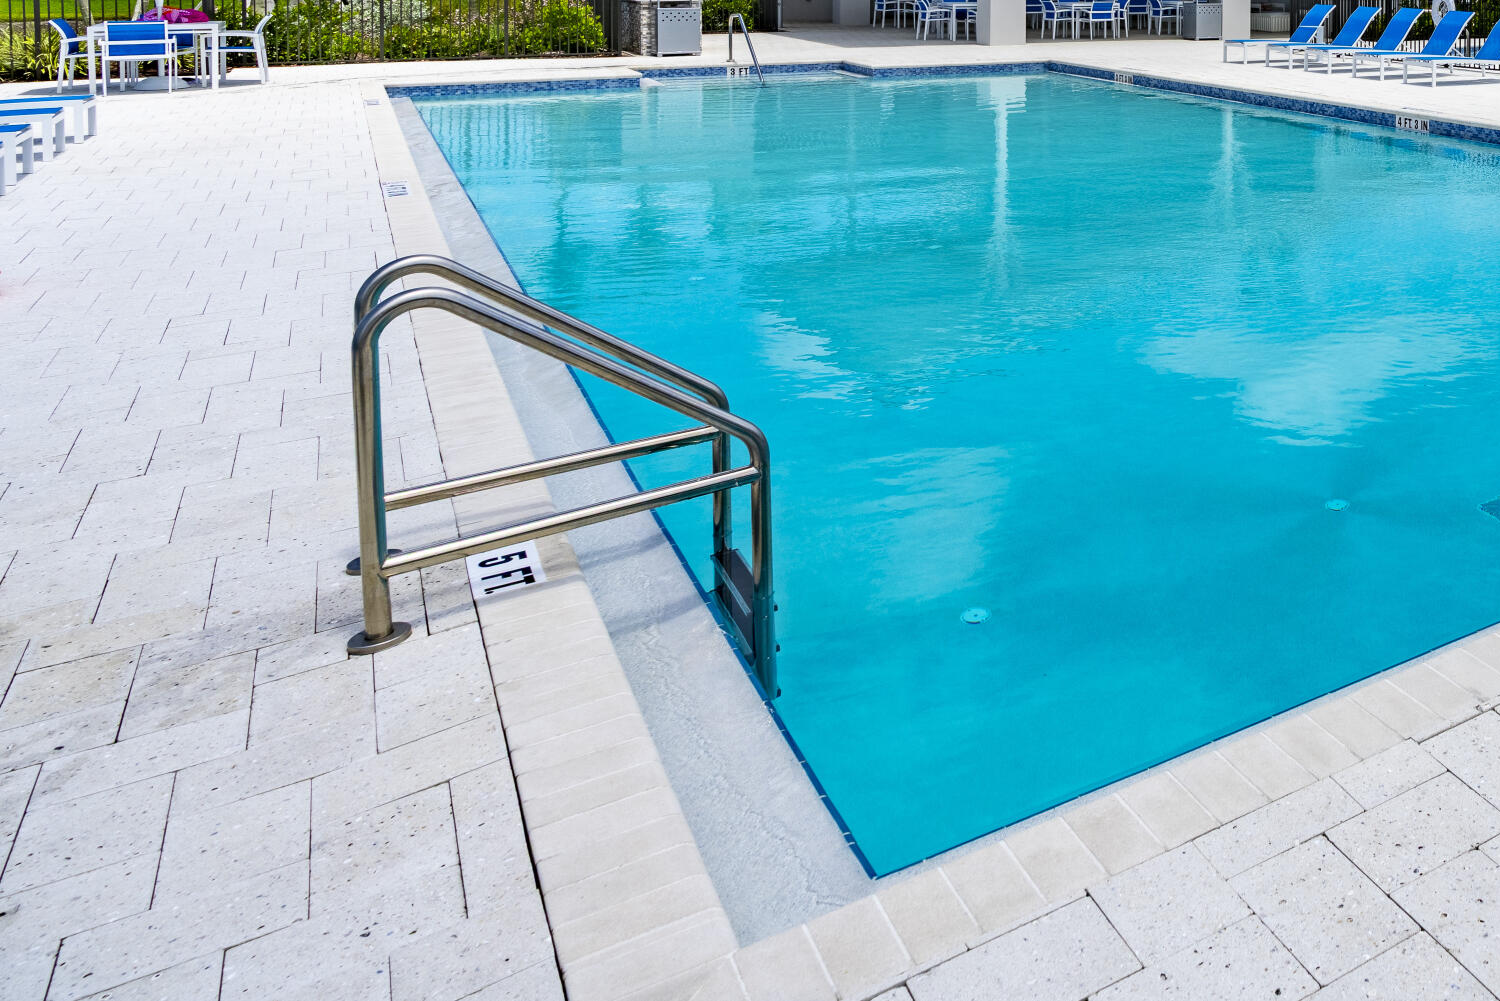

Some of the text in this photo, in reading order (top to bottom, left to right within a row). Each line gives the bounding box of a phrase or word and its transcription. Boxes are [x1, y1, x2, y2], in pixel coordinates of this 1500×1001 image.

[730, 67, 735, 75] 3
[1397, 116, 1402, 127] 4
[1414, 119, 1419, 130] 3
[1420, 119, 1428, 131] IN
[478, 550, 536, 595] 5 FT.
